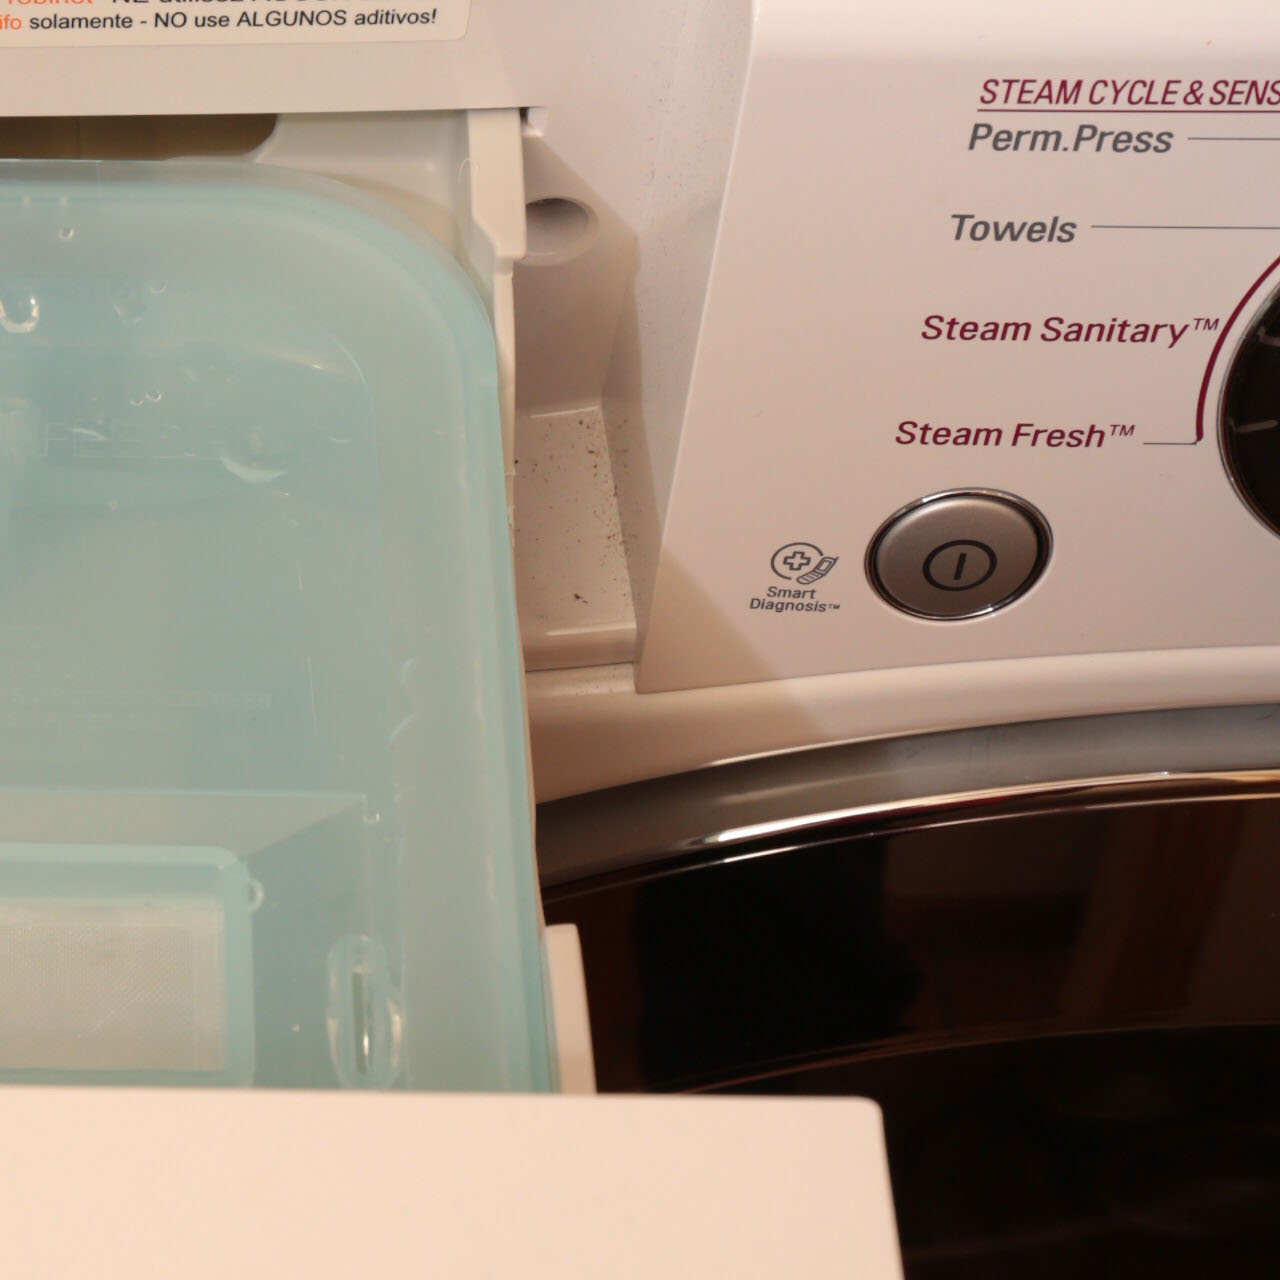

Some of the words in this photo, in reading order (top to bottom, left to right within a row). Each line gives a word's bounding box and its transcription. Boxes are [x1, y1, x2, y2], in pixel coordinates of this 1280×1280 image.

[30, 14, 133, 29] solamente
[155, 12, 187, 28] NO
[195, 16, 230, 27] use
[237, 10, 346, 27] ALGUNOS
[354, 8, 437, 25] aditivos!
[980, 79, 1083, 104] STEAM
[1089, 80, 1181, 105] CYCLE
[1183, 80, 1203, 105] &
[968, 123, 1174, 153] Perm.Press
[952, 214, 1077, 243] Towels
[922, 315, 1031, 341] Steam
[896, 421, 1002, 446] Steam
[767, 586, 816, 599] Smart
